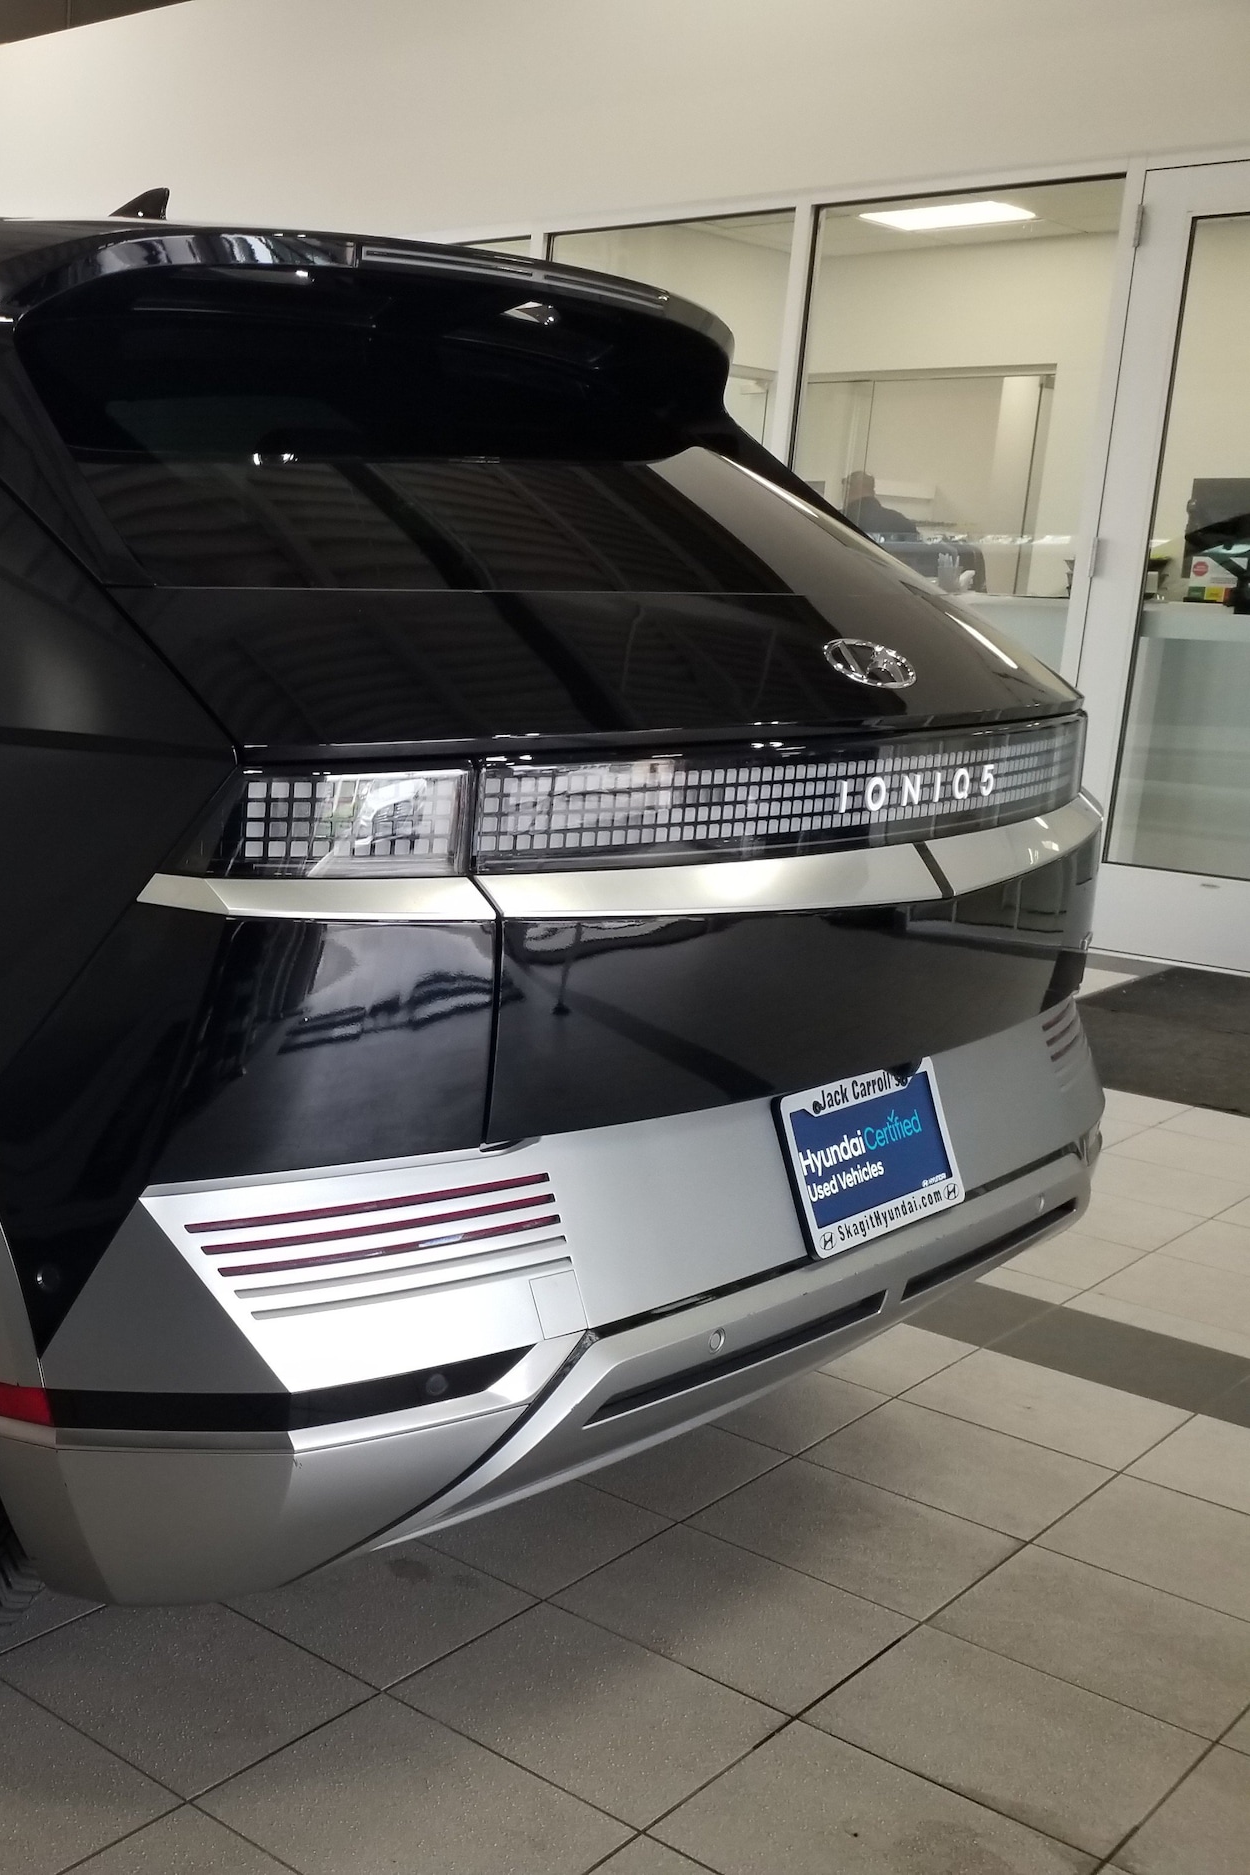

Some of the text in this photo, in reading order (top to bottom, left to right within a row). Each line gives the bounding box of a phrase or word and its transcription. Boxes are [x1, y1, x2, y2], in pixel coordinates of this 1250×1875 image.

[838, 763, 995, 814] IONIQ 5
[820, 1084, 850, 1111] Jack
[807, 1160, 885, 1203] Used Vehicles
[836, 1187, 944, 1242] SkagitHyundai.com
